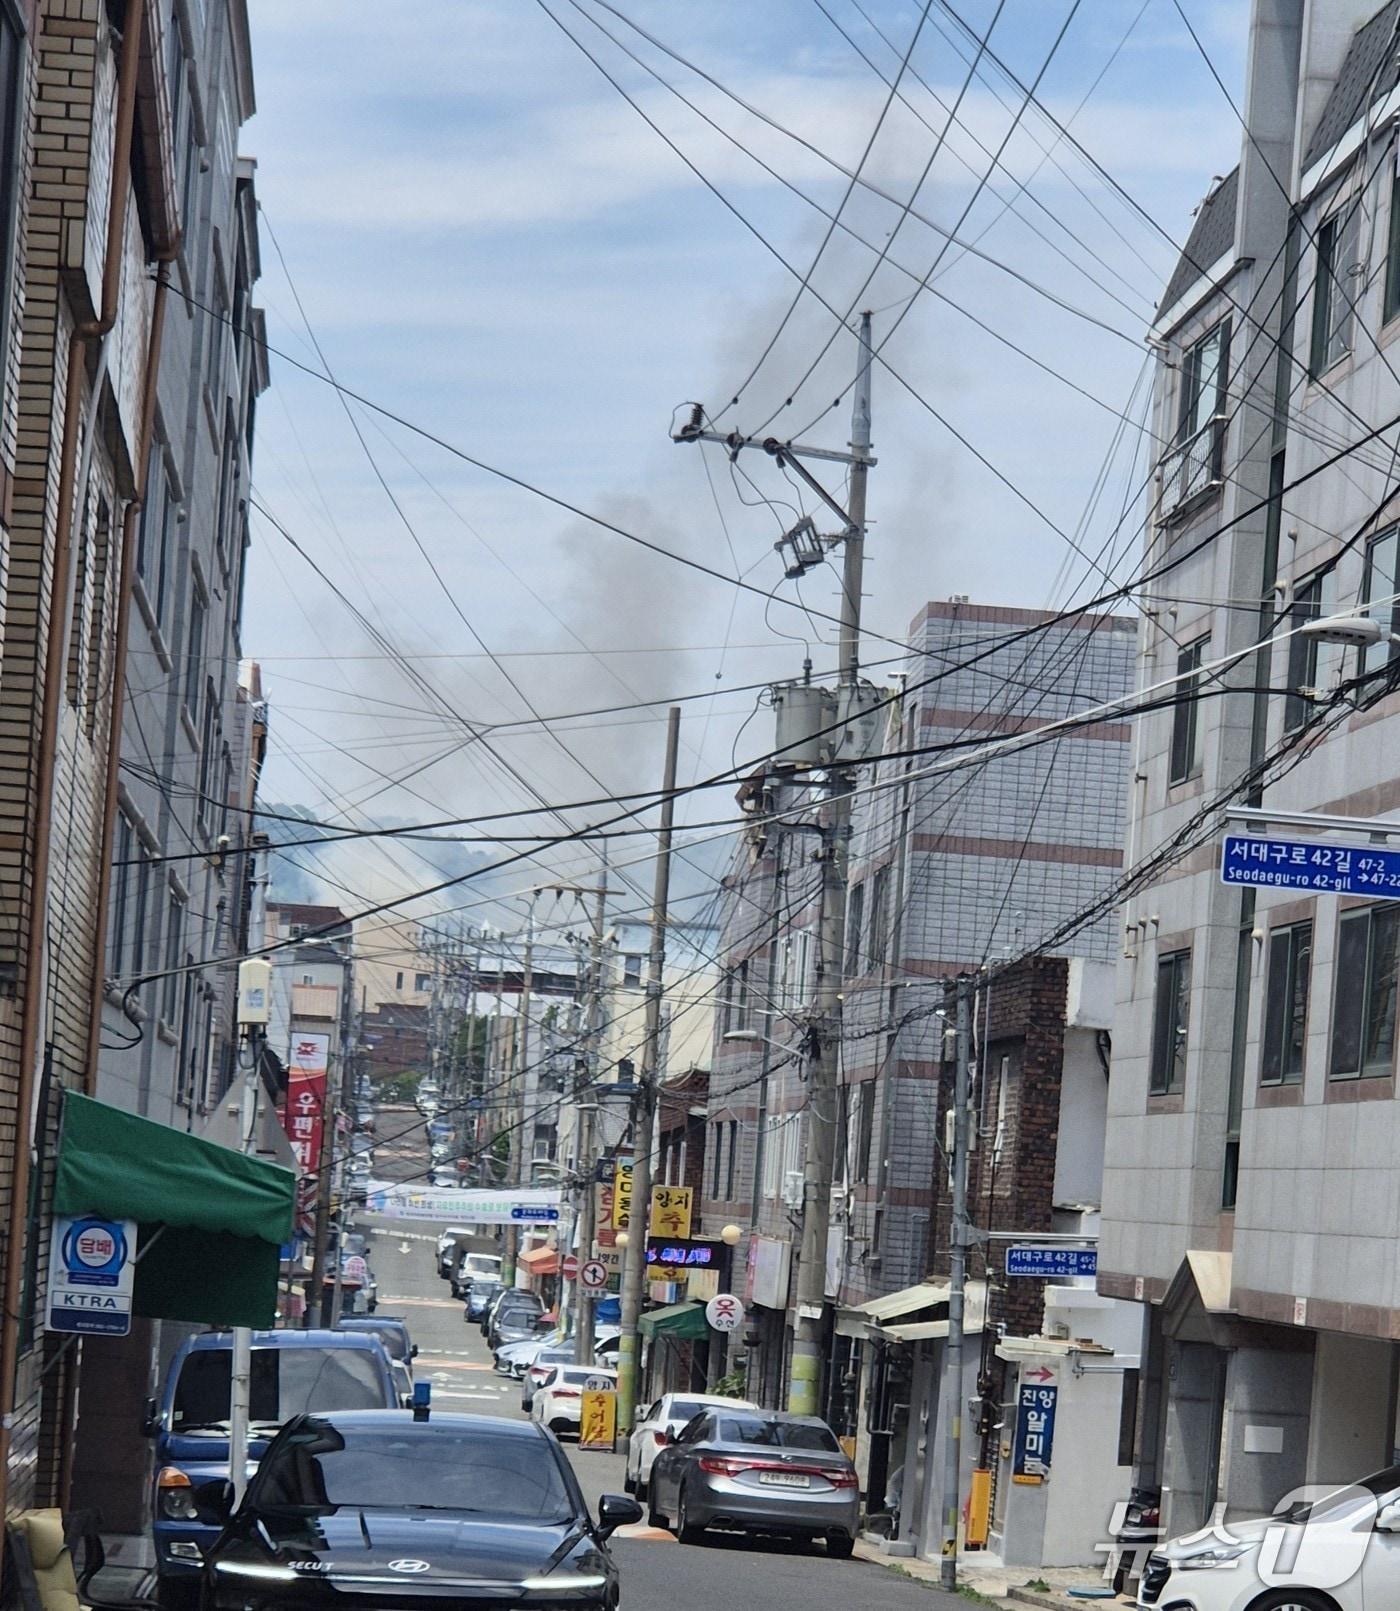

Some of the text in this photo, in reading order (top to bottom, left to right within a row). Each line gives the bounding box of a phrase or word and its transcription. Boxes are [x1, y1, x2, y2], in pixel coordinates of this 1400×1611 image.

[1358, 858, 1385, 872] 47-2
[1228, 866, 1351, 891] Seodaegu-ro 42-gil
[655, 1190, 689, 1210] 양지
[80, 1238, 111, 1255] 담배
[1010, 1264, 1078, 1275] Seodaegu-ro 42-gil
[64, 1294, 117, 1308] KTRA
[1022, 1389, 1055, 1409] 진양
